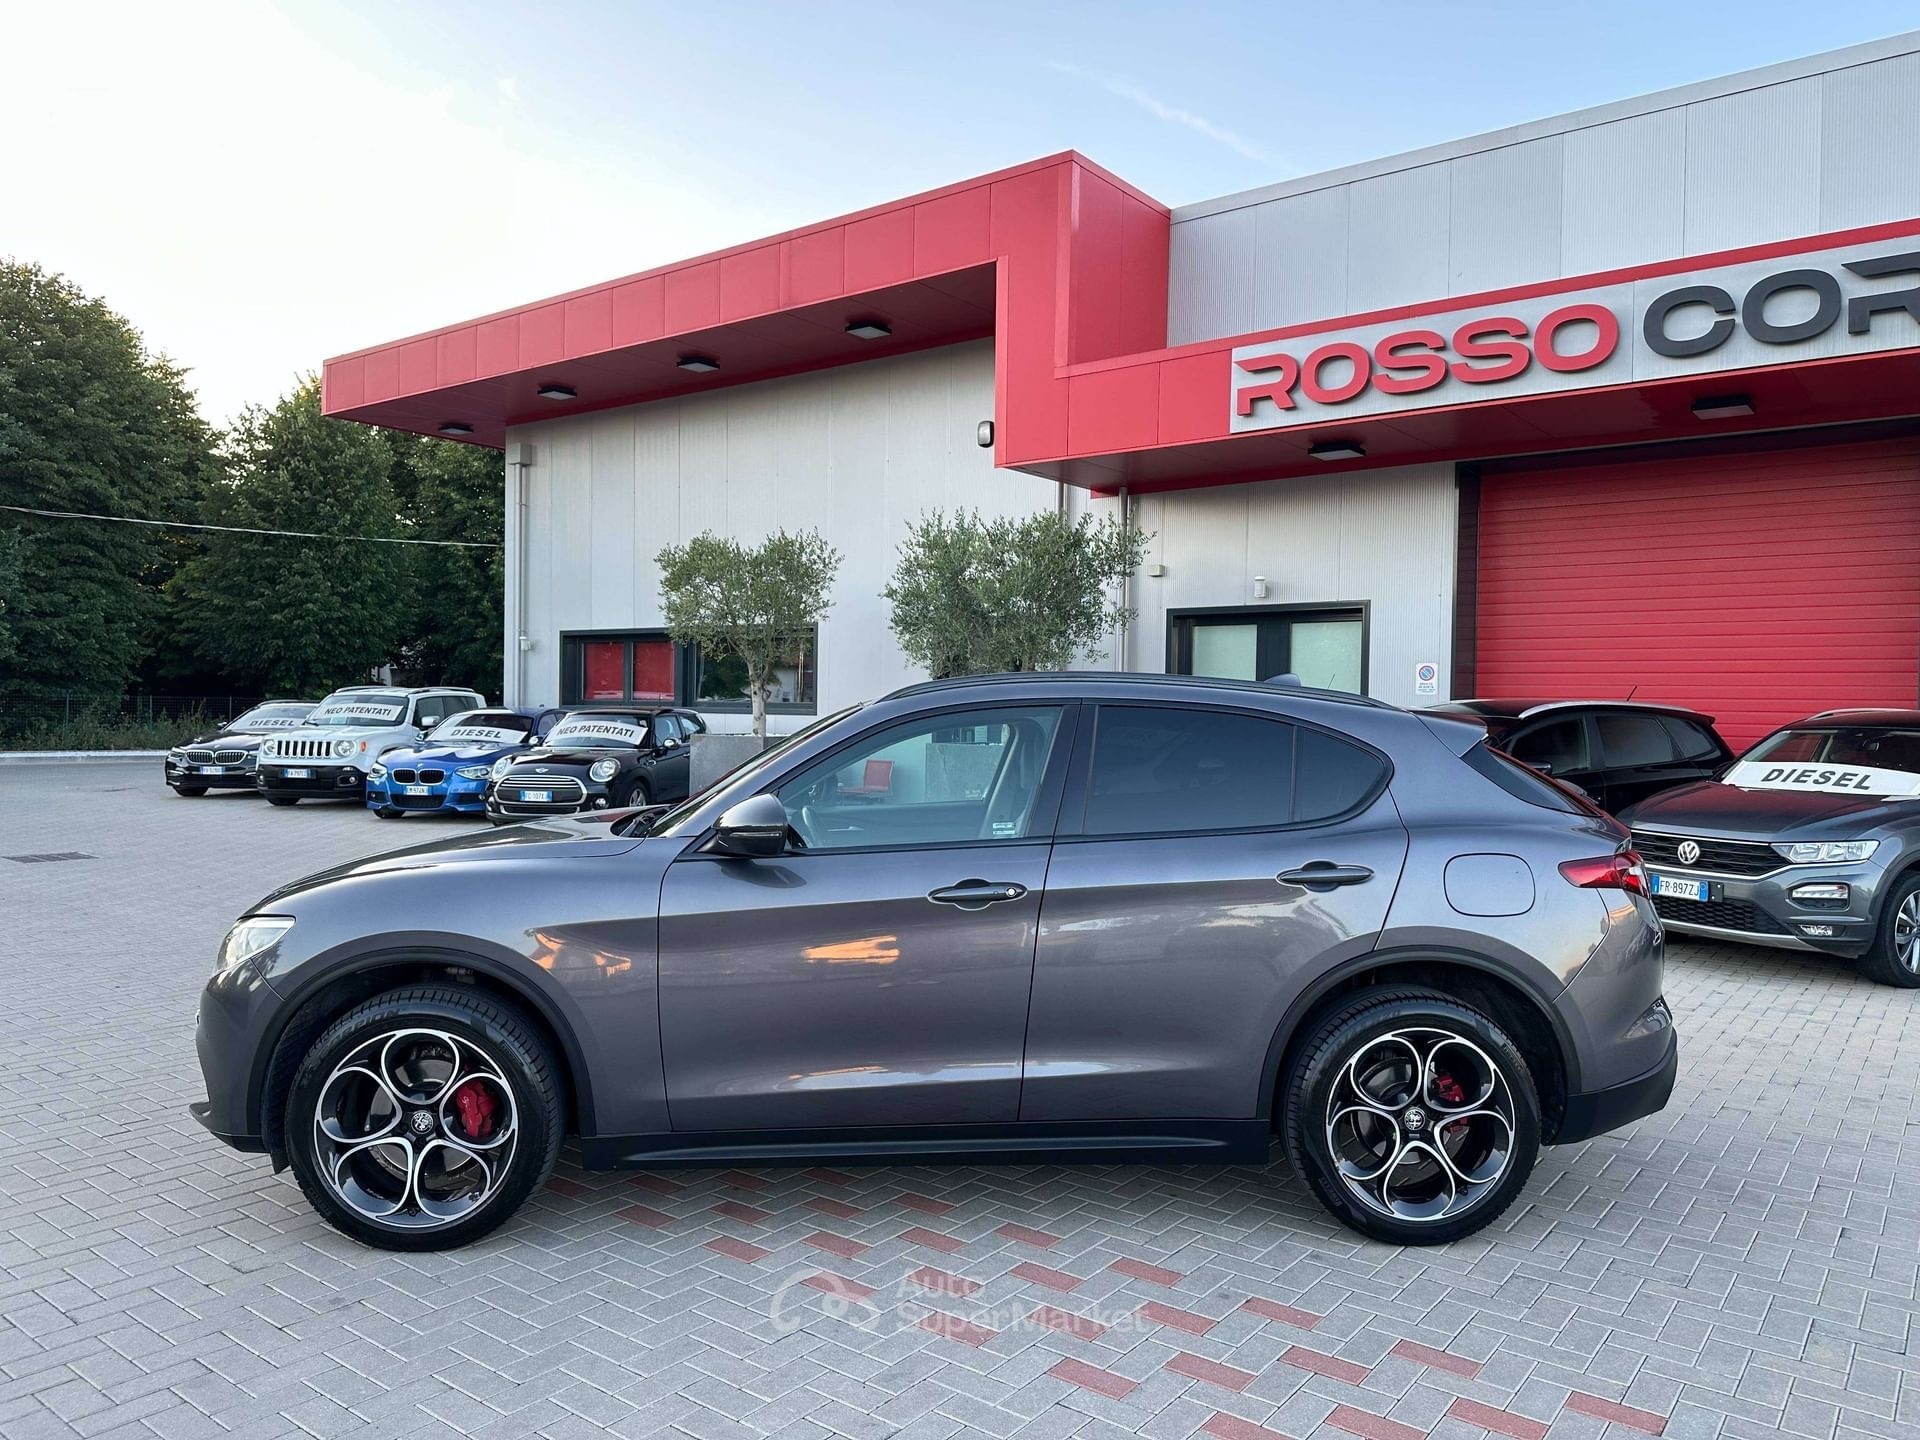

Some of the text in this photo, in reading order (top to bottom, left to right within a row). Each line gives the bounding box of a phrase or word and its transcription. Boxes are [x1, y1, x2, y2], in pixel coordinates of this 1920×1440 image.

[1233, 303, 1620, 417] ROSSO
[325, 705, 392, 716] NEO PATENTATI
[250, 719, 294, 727] DIESEL
[451, 728, 502, 739] DIESEL
[556, 724, 635, 738] NEO PATENTATI
[1761, 768, 1872, 791] DIESEL
